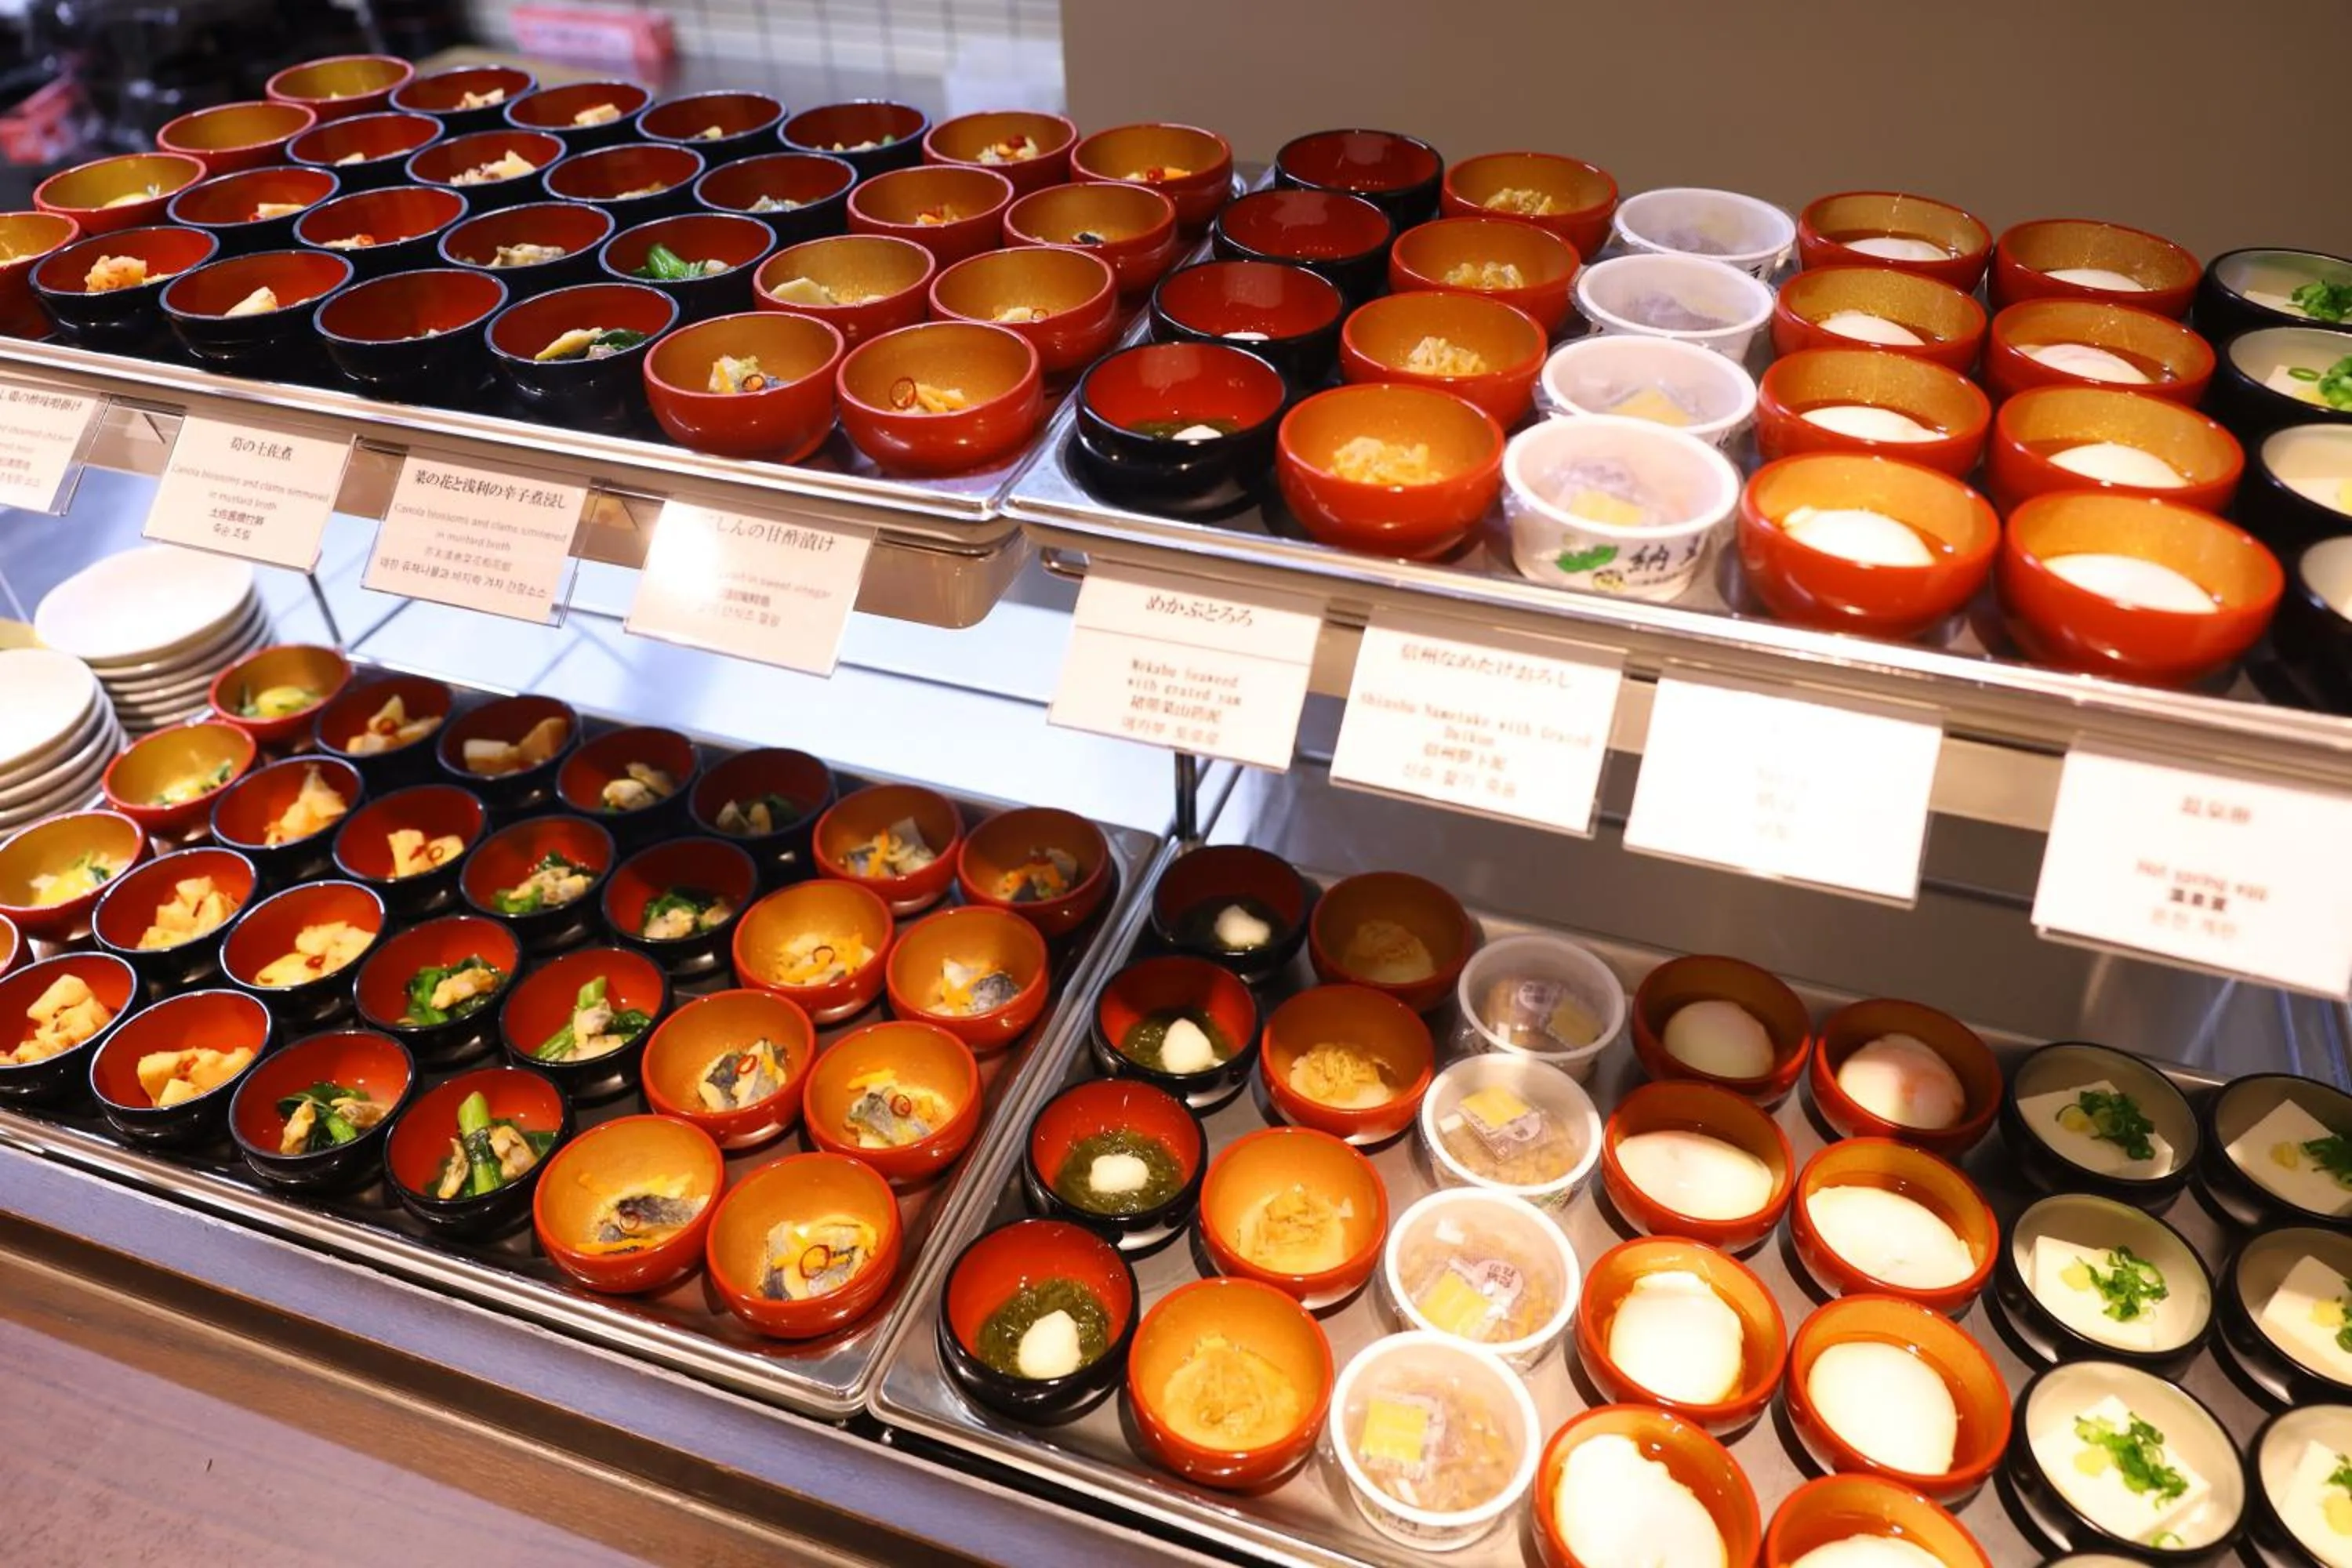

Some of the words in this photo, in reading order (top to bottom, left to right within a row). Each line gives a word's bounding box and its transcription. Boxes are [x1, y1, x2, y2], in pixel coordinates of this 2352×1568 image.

[415, 469, 566, 510] 菜の花と浅利の辛子煮浸し
[471, 517, 489, 530] and
[707, 514, 837, 552] しんの甘酢漬け
[1145, 594, 1254, 628] めかぶとろろ
[1400, 642, 1573, 690] 信州なめたけおろし
